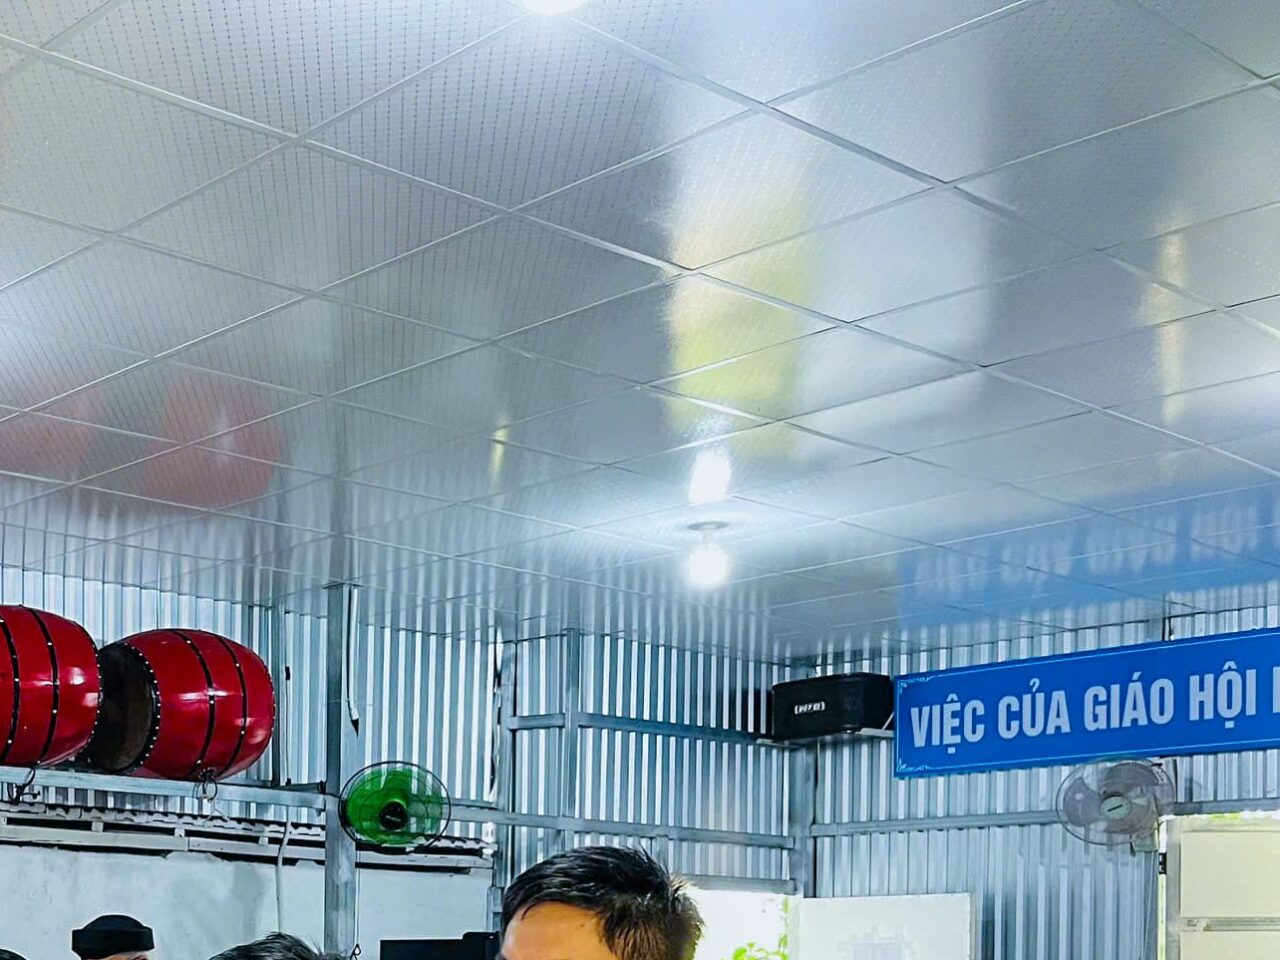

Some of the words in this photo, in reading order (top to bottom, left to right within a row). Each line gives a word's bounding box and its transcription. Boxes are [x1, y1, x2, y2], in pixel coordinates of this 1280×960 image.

[910, 693, 985, 754] VIỆC
[997, 677, 1071, 740] CỦA
[1083, 671, 1174, 731] GIÁO
[1189, 660, 1257, 729] HỘI
